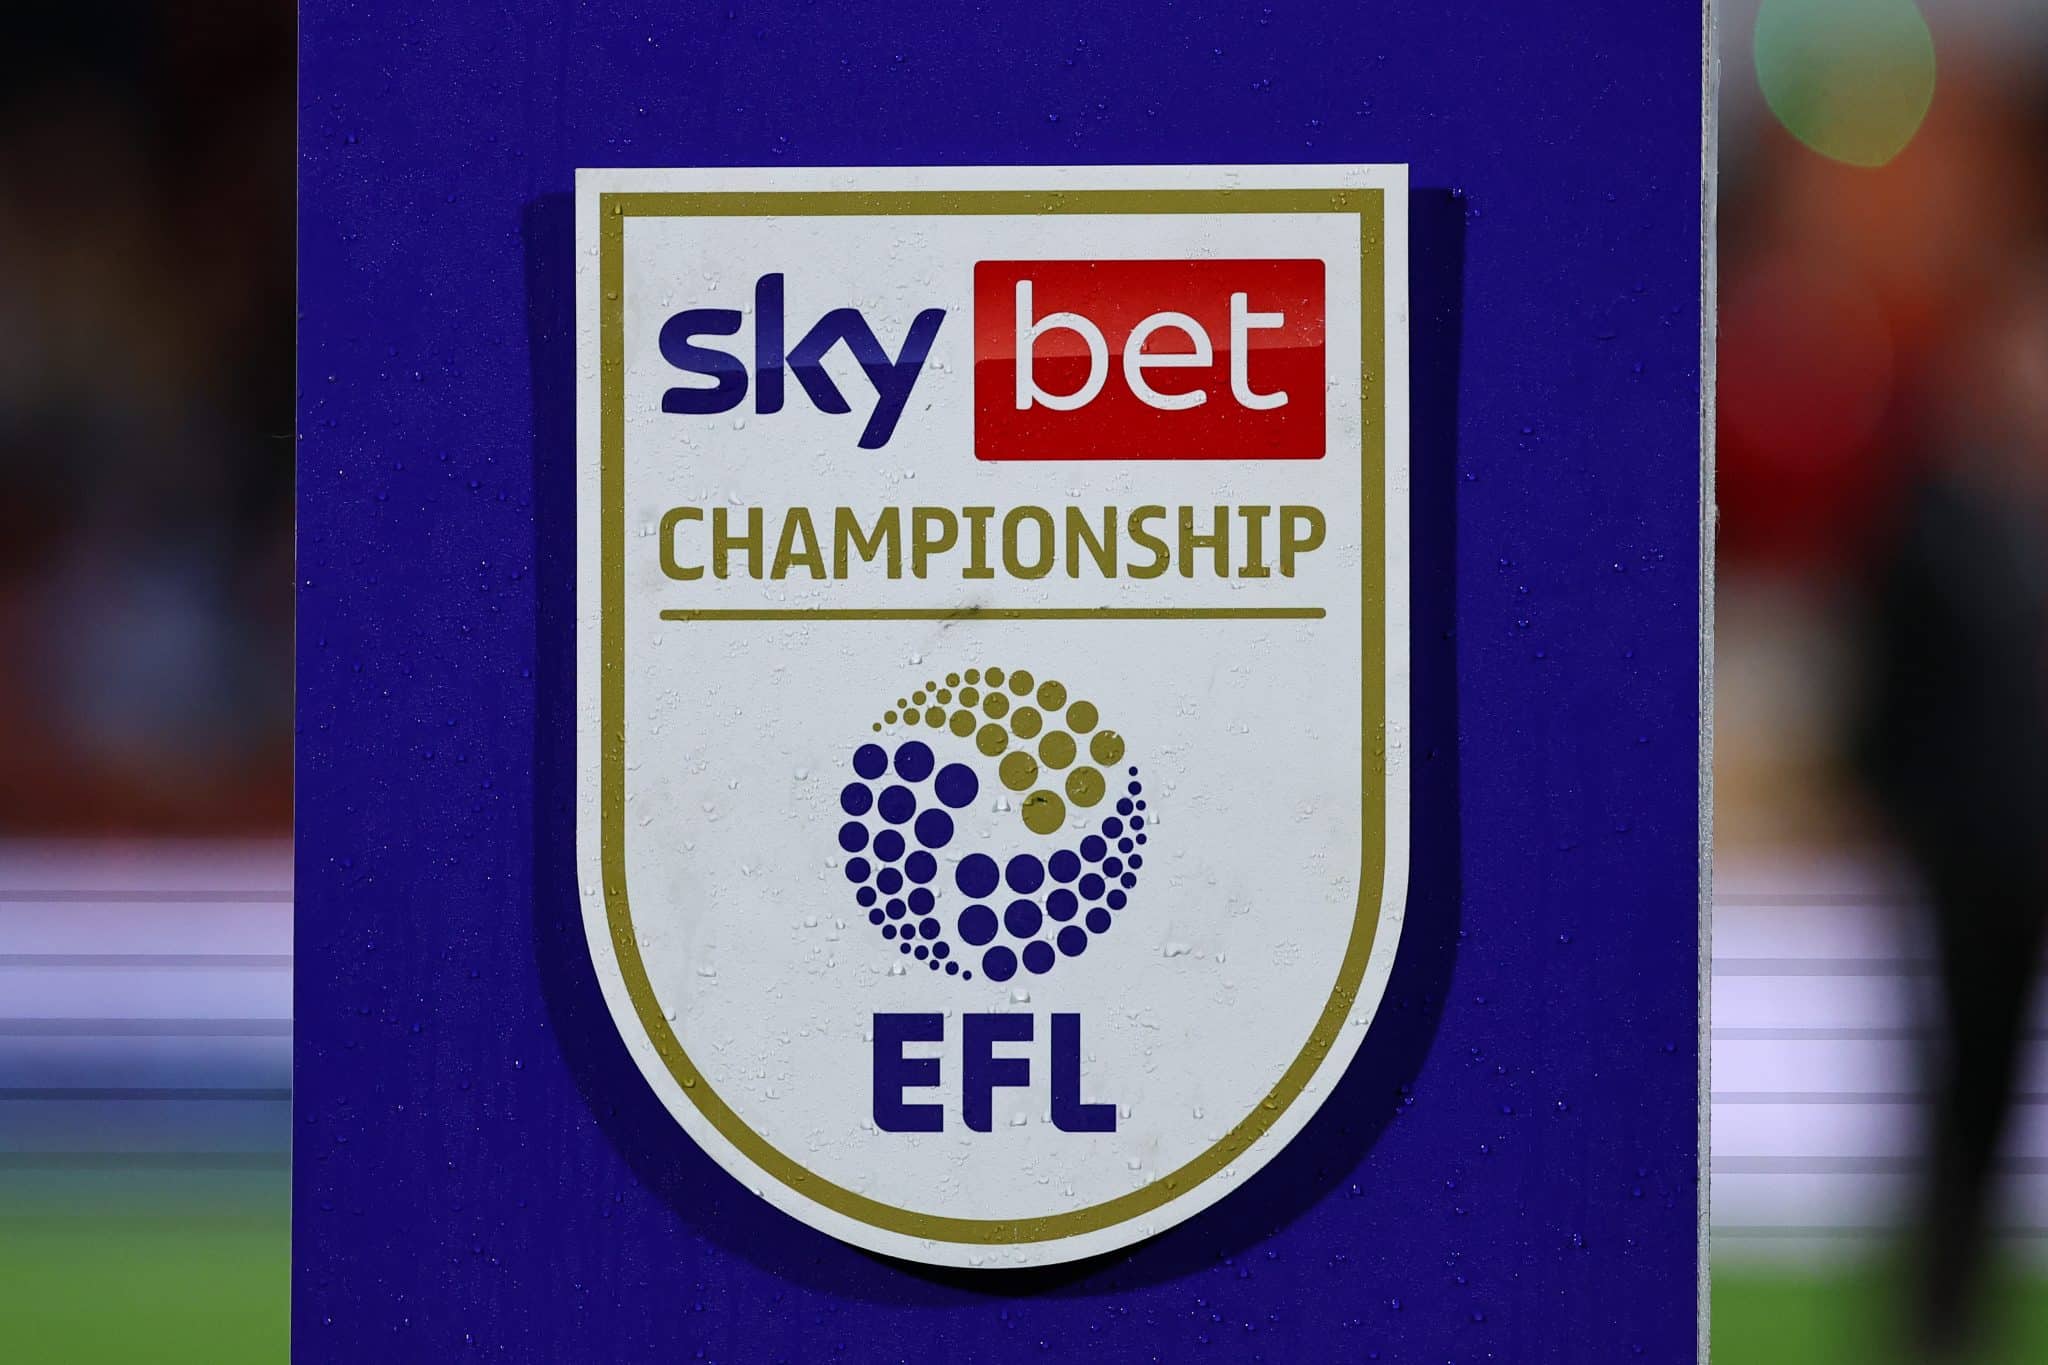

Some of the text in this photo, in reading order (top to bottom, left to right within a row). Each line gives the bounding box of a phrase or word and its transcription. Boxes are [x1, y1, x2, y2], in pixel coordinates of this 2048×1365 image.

[658, 273, 1289, 450] sky bet
[659, 505, 1326, 581] CHAMPIONSHIP
[873, 1013, 1117, 1133] EFL
